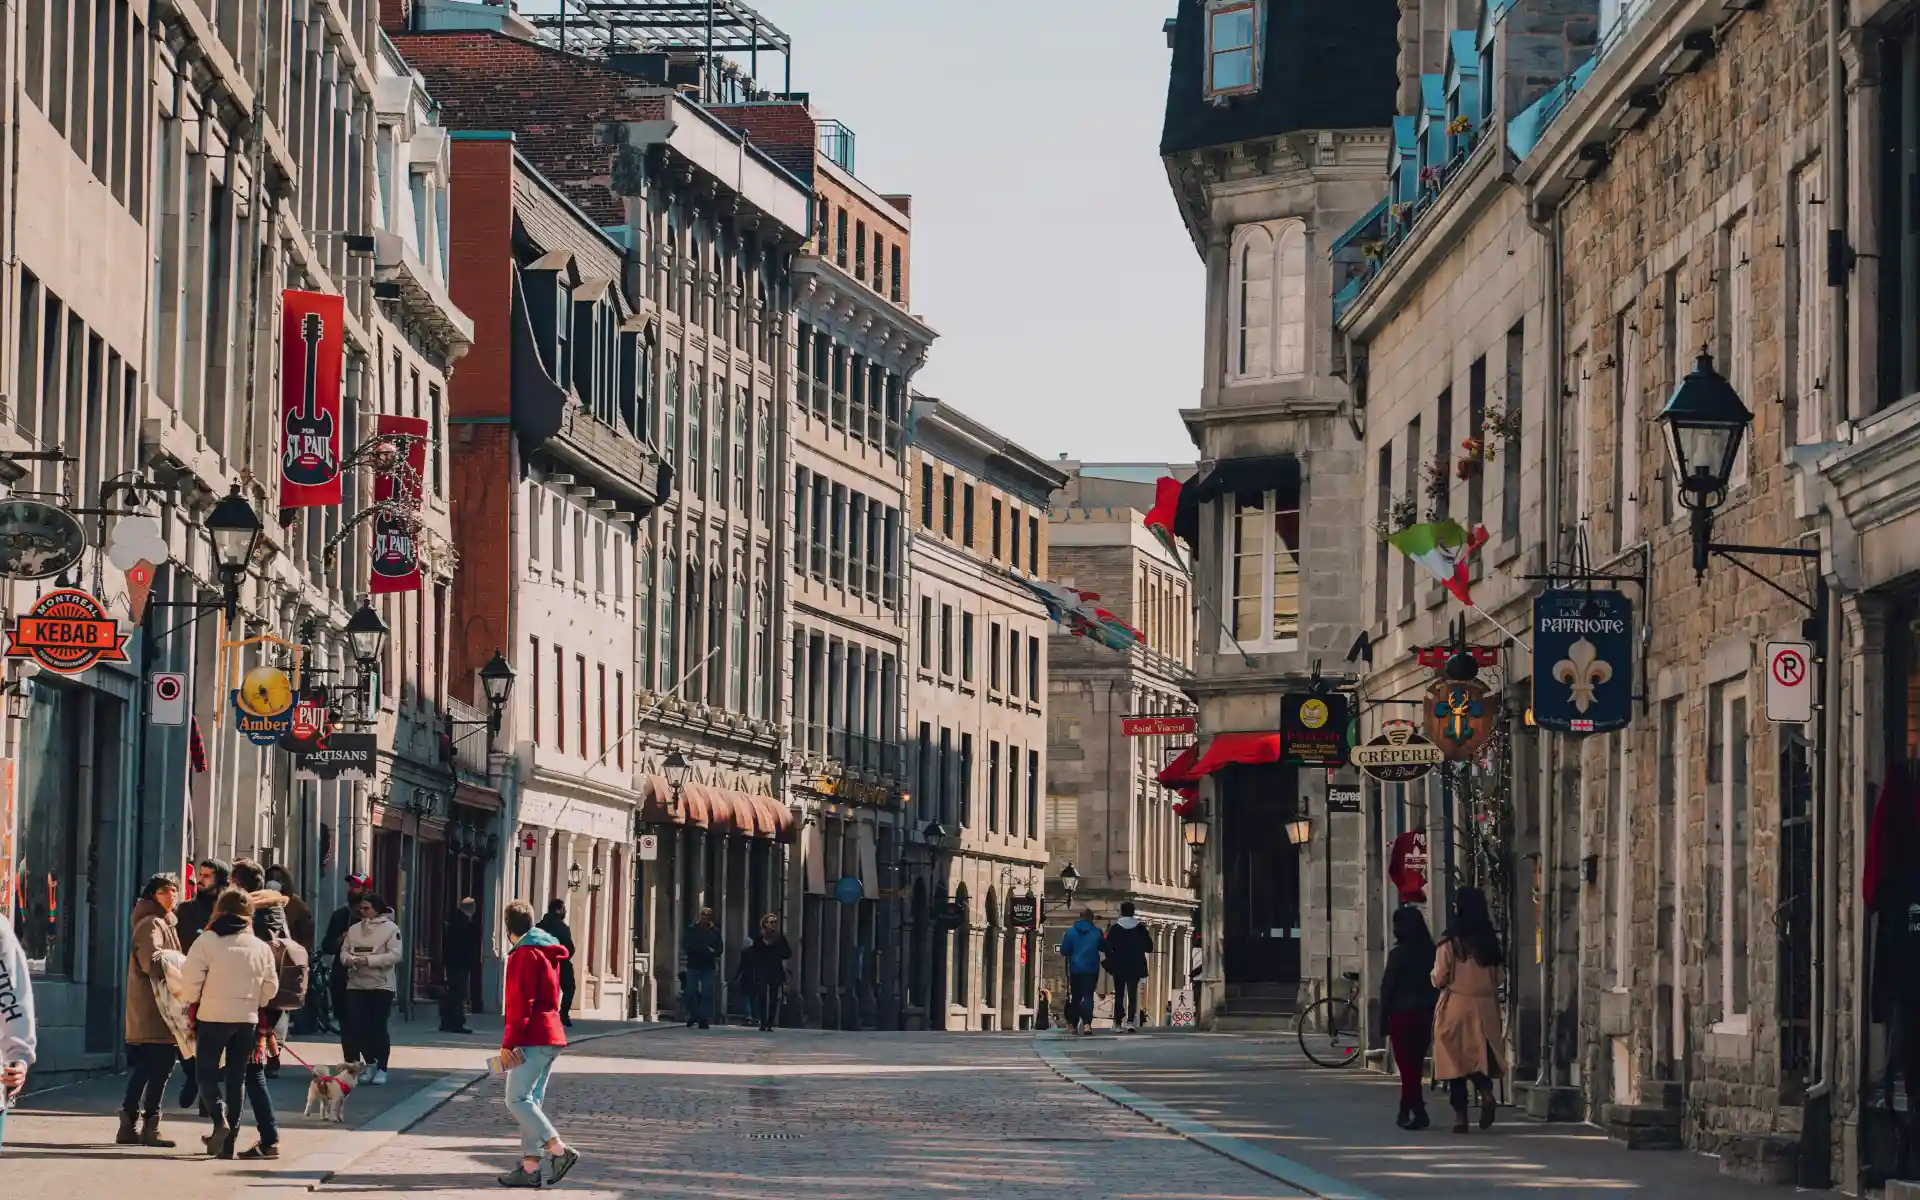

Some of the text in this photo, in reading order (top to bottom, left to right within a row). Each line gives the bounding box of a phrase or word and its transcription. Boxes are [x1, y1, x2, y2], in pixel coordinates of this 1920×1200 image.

[303, 435, 333, 469] PAUL
[35, 622, 98, 644] KEBAB
[1541, 618, 1624, 634] PATRIOTE
[239, 716, 289, 732] Amber
[299, 707, 326, 739] PAUL
[1131, 723, 1185, 733] Saint Vincent
[305, 750, 368, 761] ARTISANS
[1358, 748, 1440, 763] CRÊPERIE
[1395, 766, 1418, 777] Paul
